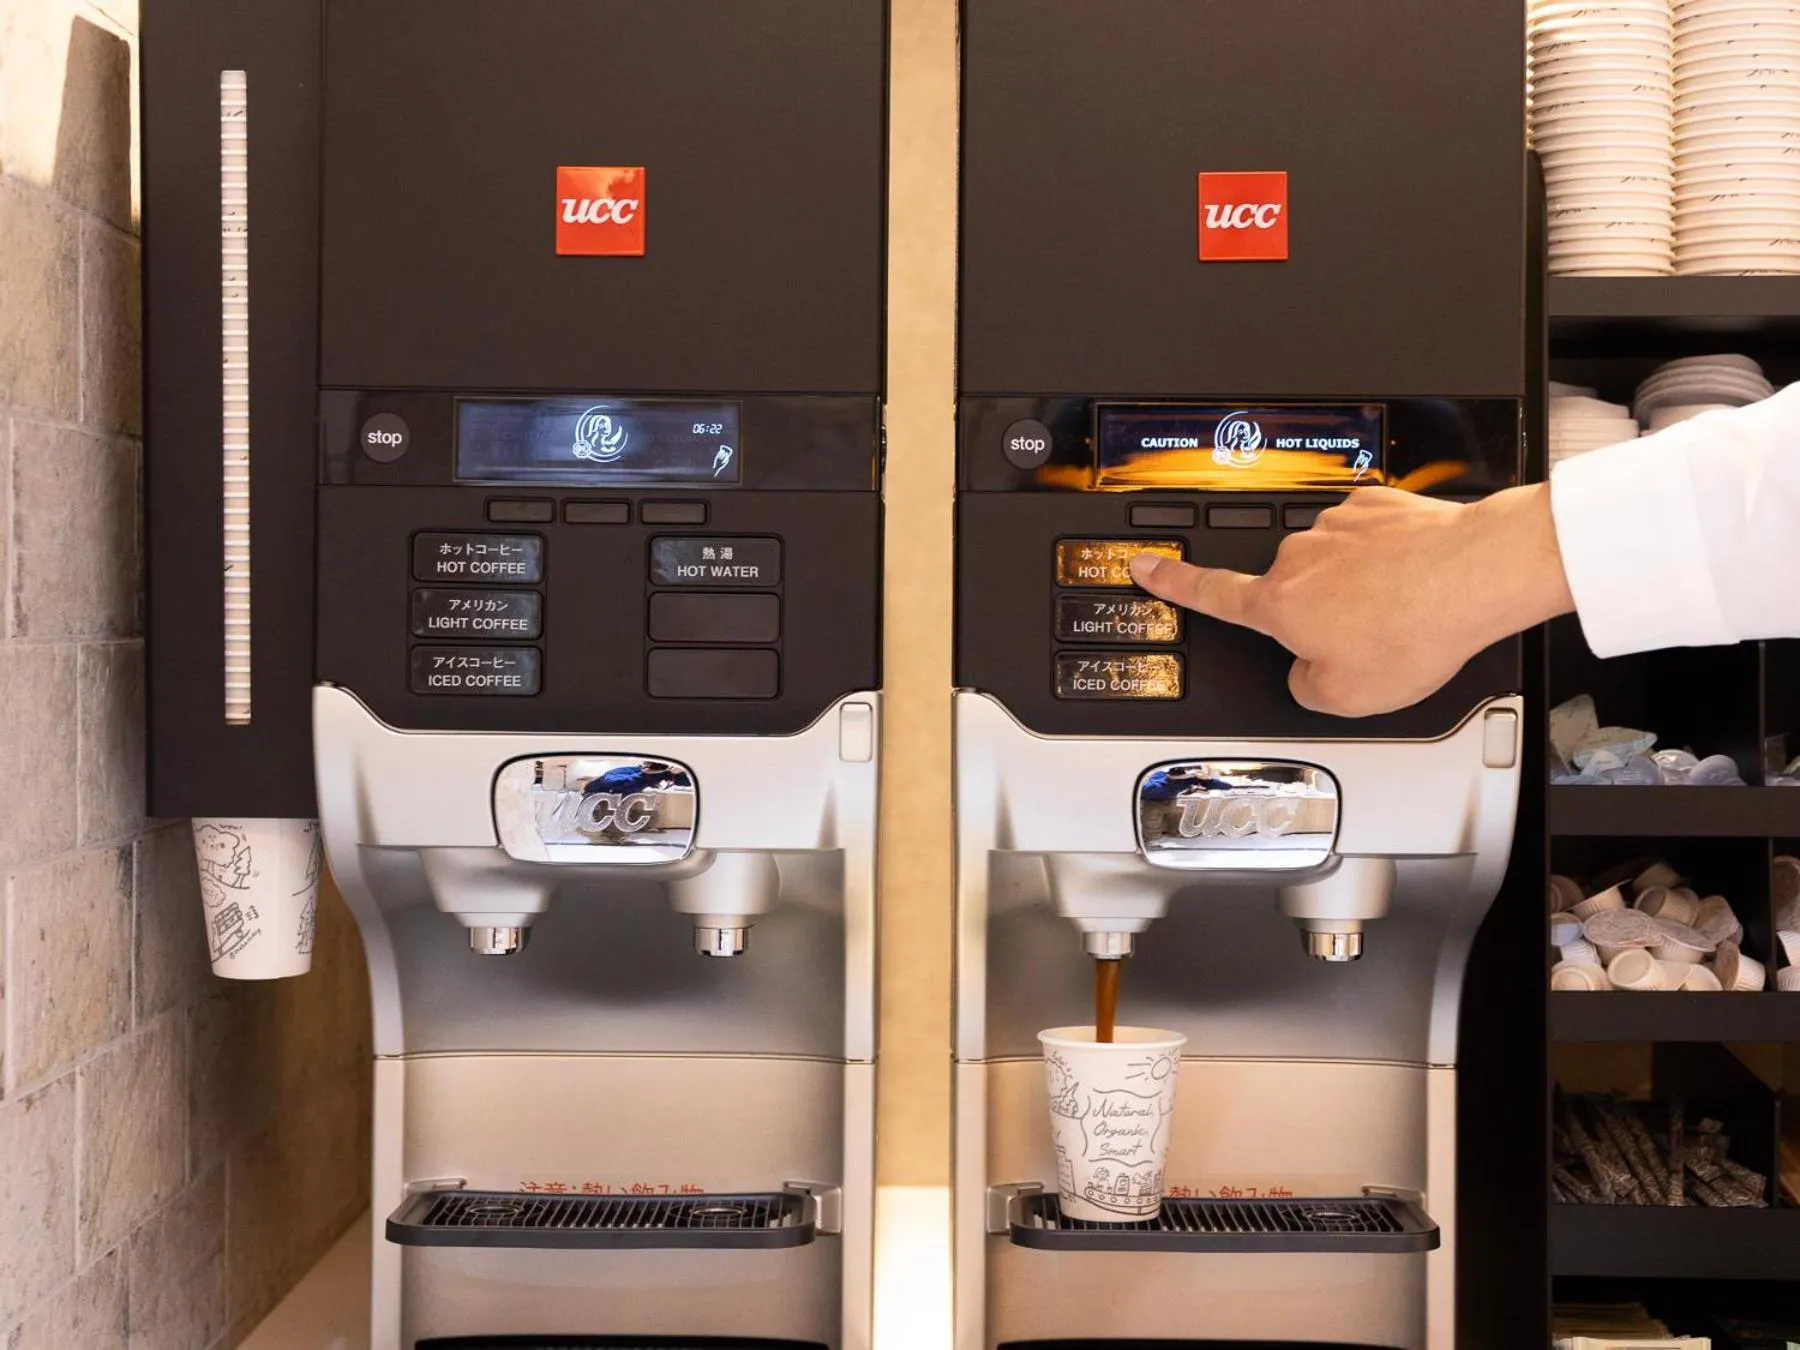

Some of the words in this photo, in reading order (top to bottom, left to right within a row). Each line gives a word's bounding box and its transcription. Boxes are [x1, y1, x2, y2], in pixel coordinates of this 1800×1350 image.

[692, 423, 724, 434] 06:22
[367, 429, 402, 448] stop
[1010, 435, 1045, 453] stop
[1141, 437, 1198, 448] CAUTION
[1276, 438, 1302, 449] HOT
[1305, 437, 1360, 450] LIQUIDS
[439, 542, 523, 556] ホットコーヒー
[1081, 548, 1136, 560] ホットコー
[437, 561, 467, 573] HOT
[470, 562, 526, 574] COFFEE
[677, 565, 705, 577] HOT
[709, 565, 760, 579] WATER
[1079, 566, 1108, 578] HOT
[448, 599, 509, 612] アメリカン
[1093, 603, 1153, 615] アメリカン
[428, 617, 469, 629] LIGHT
[472, 618, 529, 630] COFFEE
[1073, 621, 1113, 633] LIGHT
[1117, 622, 1173, 634] COFFEE
[432, 656, 516, 669] アイスコーヒー
[1078, 661, 1162, 672] アイスコーヒー
[428, 675, 461, 686] ICED
[465, 675, 522, 687] COFFEE
[1073, 679, 1106, 691] ICED
